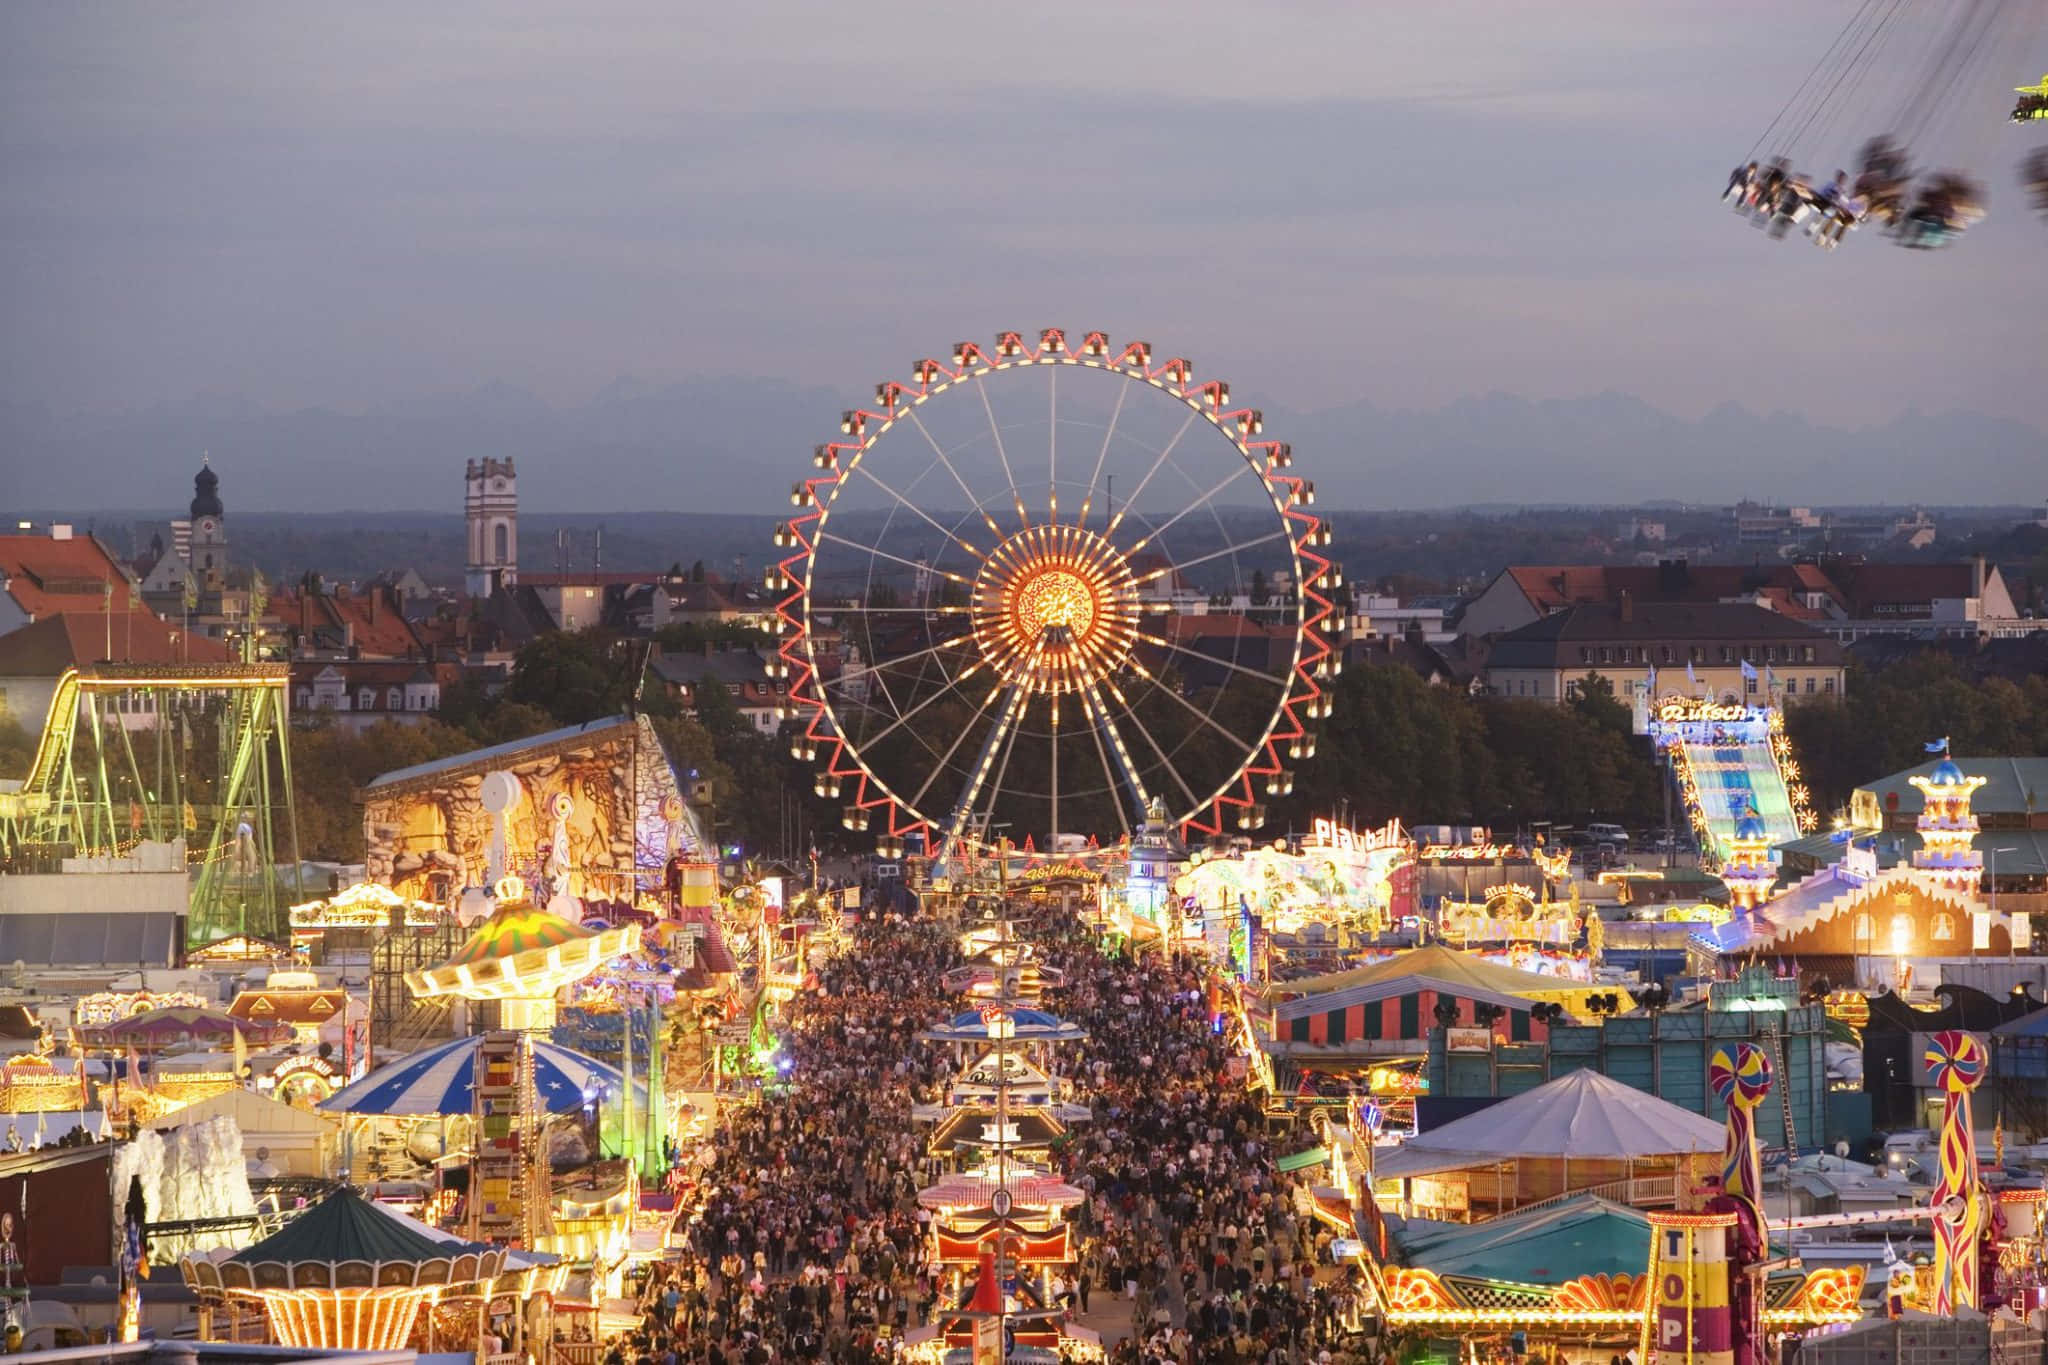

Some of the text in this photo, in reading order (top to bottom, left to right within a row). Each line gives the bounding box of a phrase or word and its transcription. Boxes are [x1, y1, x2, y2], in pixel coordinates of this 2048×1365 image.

[1661, 703, 1747, 721] Rutsch
[1315, 817, 1400, 853] Playball
[1663, 1230, 1684, 1346] TOP
